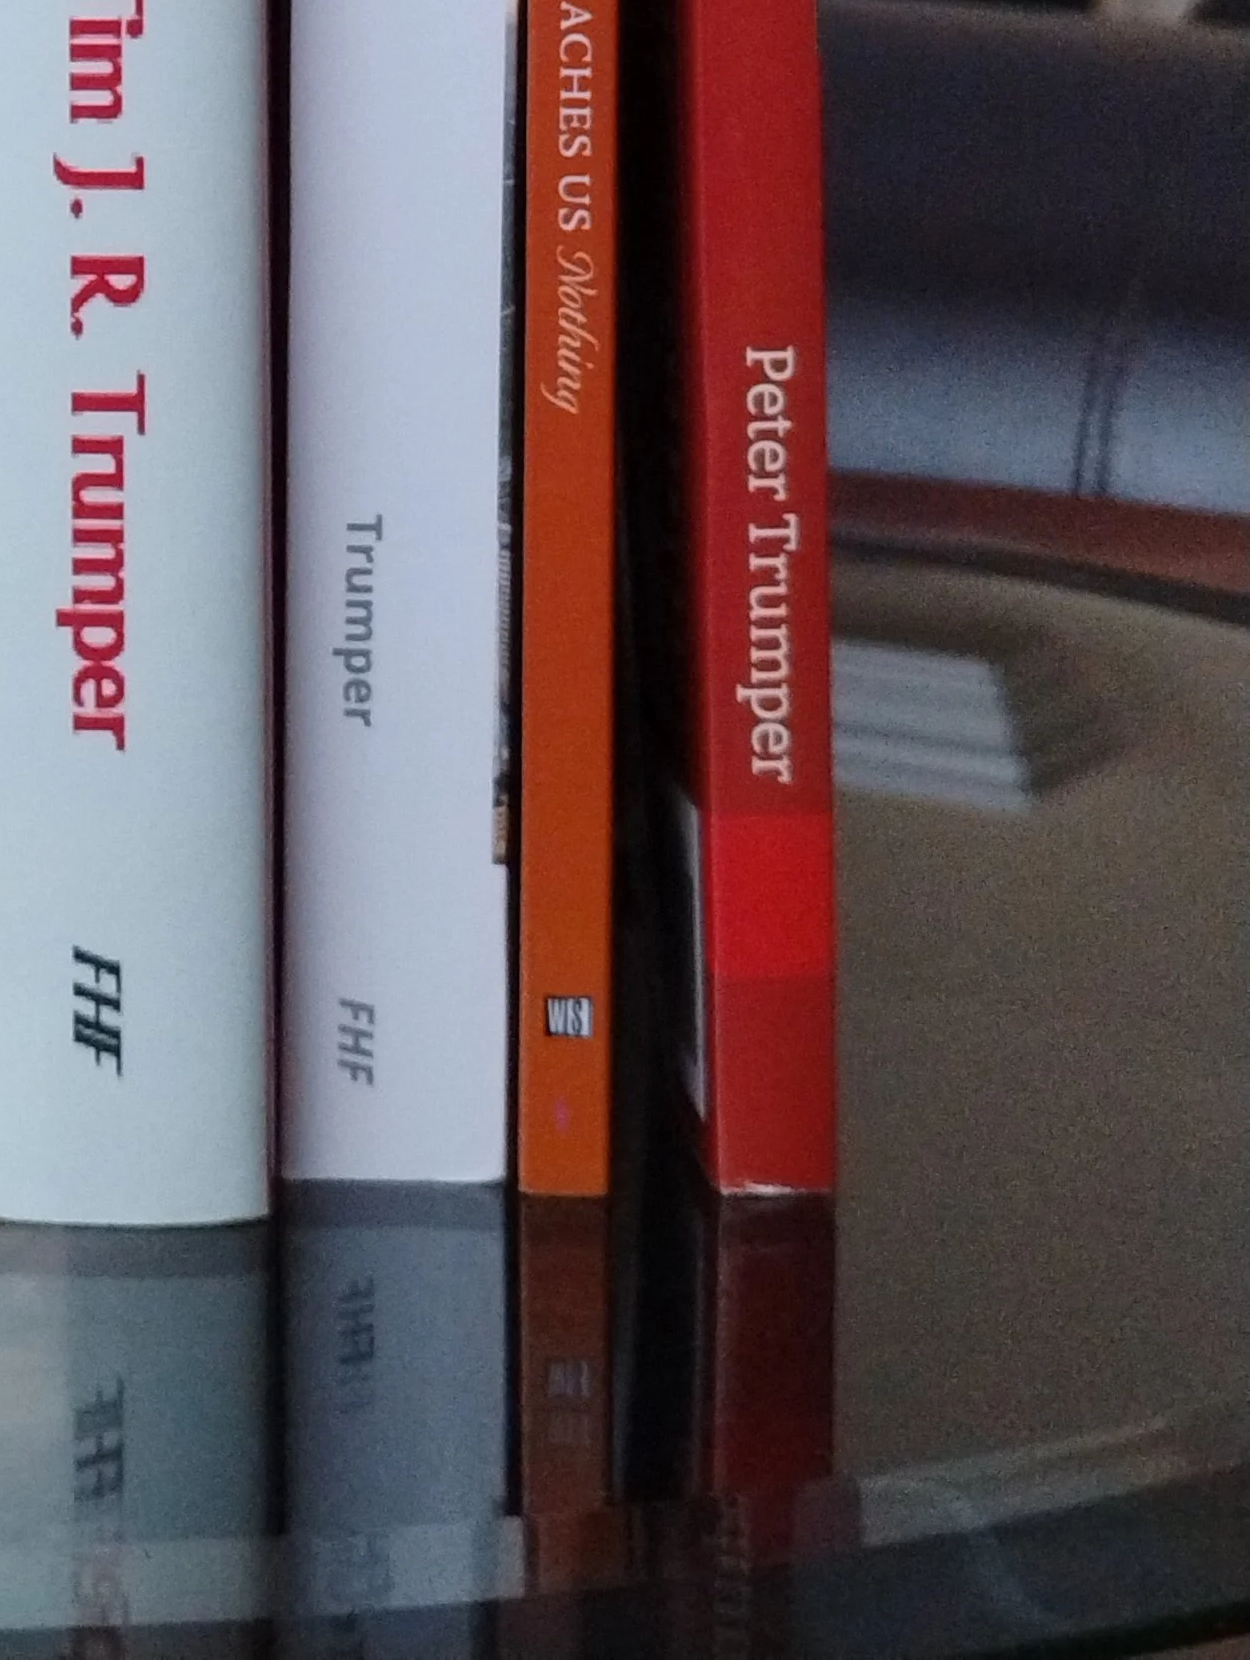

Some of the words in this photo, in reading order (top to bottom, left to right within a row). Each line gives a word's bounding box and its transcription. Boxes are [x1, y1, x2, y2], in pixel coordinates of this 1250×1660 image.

[53, 153, 146, 219] J.
[556, 174, 592, 233] US
[69, 254, 146, 338] R.
[539, 244, 601, 415] Nothing
[745, 345, 798, 503] Peter
[55, 372, 146, 752] Trumper
[331, 513, 384, 728] Trumper
[736, 512, 800, 786] Trumper
[71, 945, 123, 1077] FHF
[337, 998, 376, 1087] FHF
